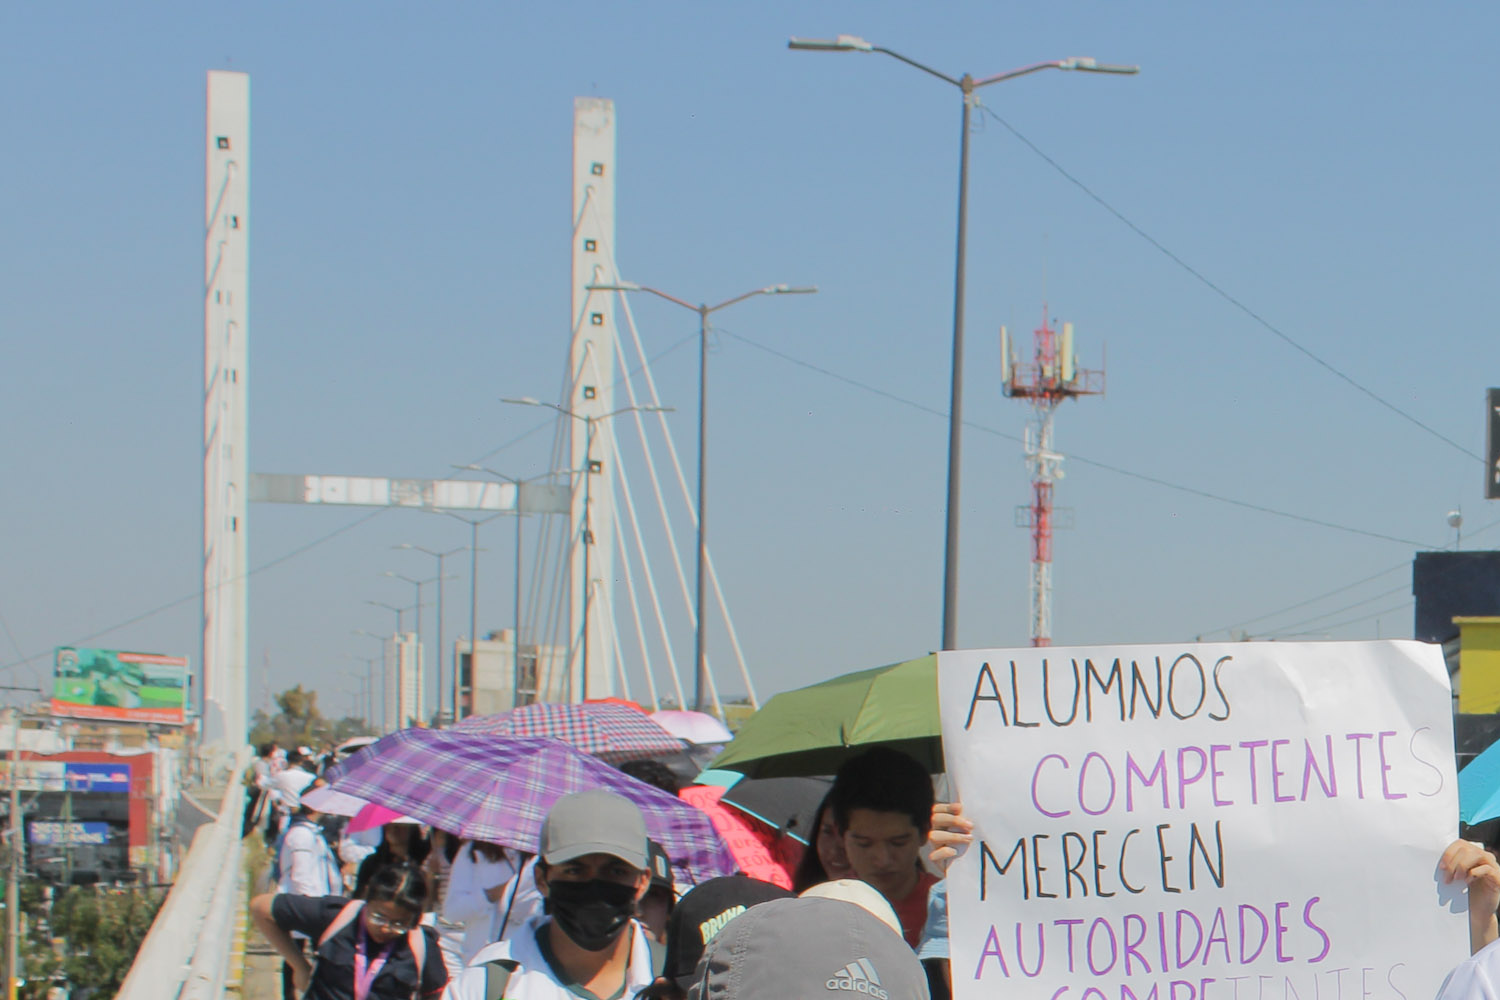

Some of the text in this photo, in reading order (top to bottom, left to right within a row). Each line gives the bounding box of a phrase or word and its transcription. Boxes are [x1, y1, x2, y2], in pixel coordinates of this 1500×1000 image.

[964, 653, 1233, 731] ALUMNOS
[1031, 727, 1443, 818] COMPETENTES
[979, 820, 1225, 901] MERECEN
[974, 896, 1331, 981] AUTORIDADES
[824, 976, 889, 1000] adidas
